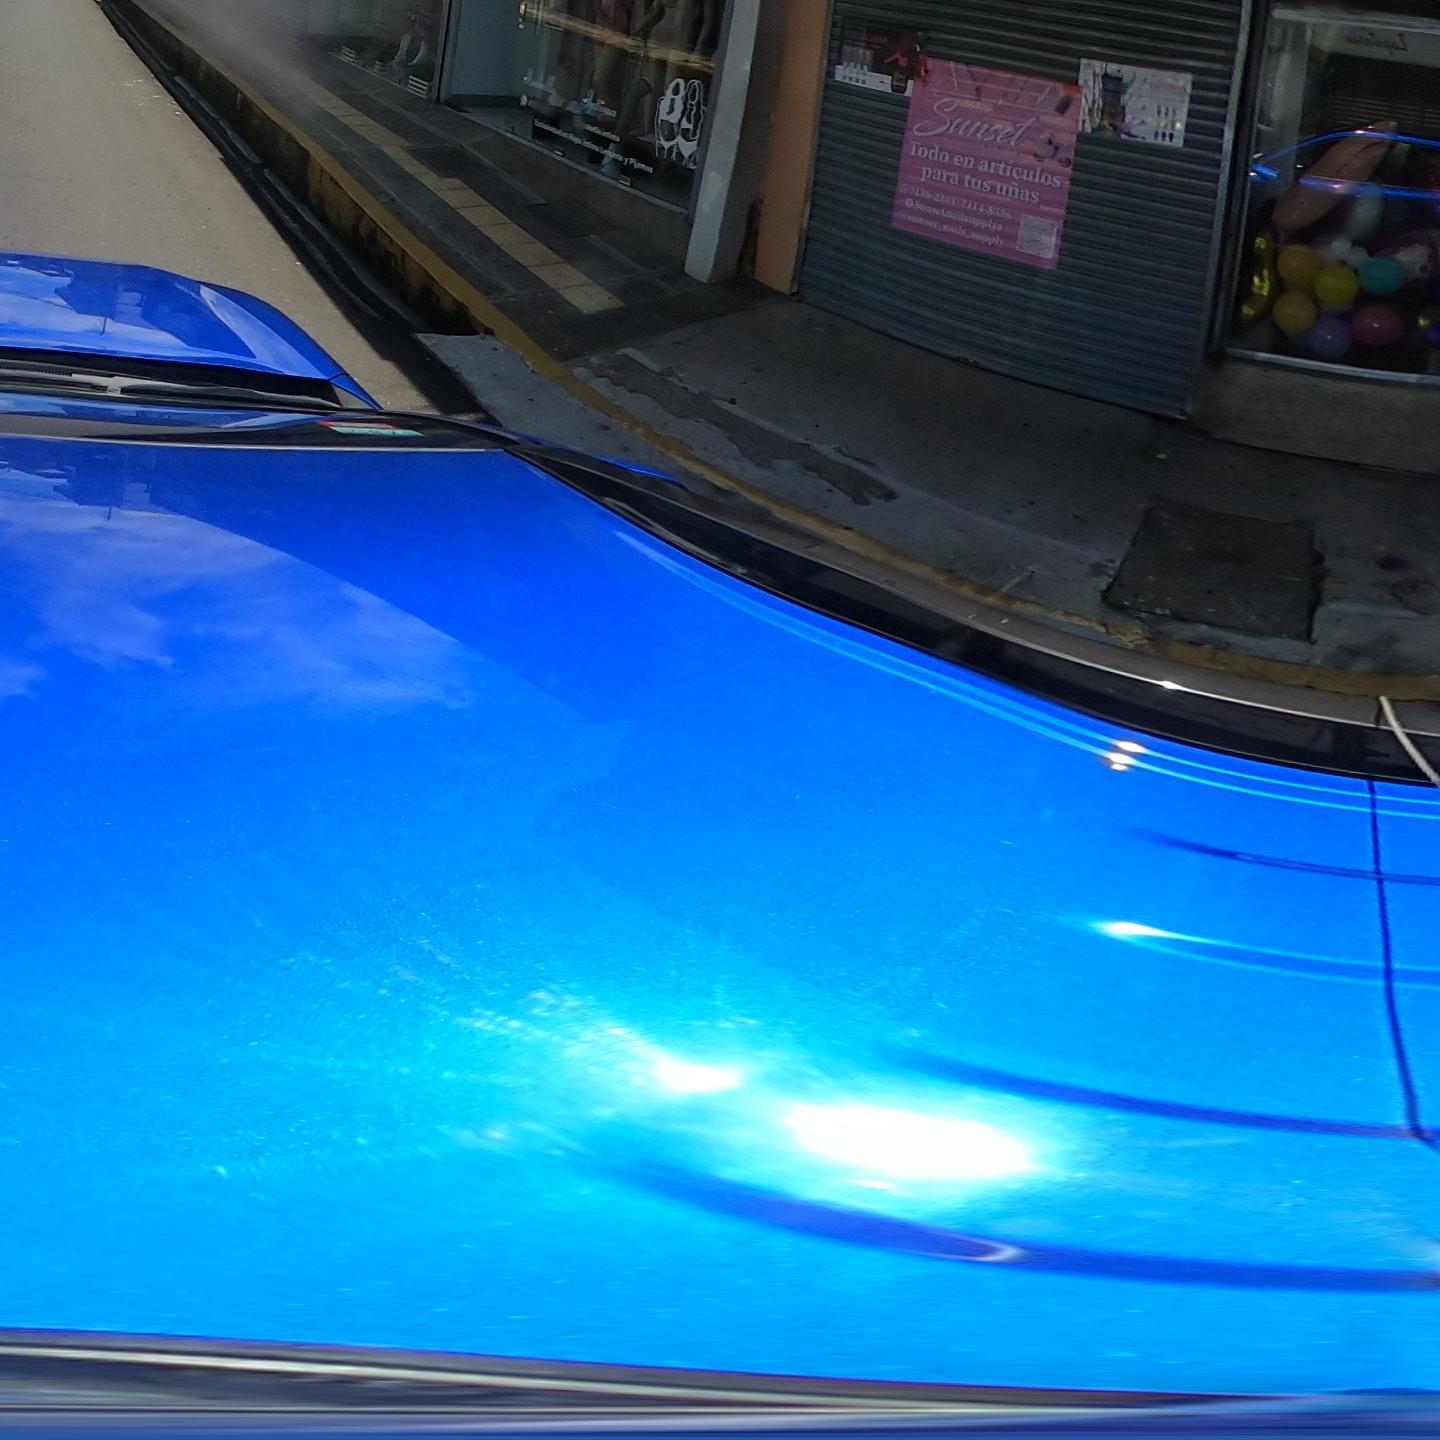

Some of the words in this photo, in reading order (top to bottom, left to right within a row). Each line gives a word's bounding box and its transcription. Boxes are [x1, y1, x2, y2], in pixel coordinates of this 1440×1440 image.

[912, 96, 1040, 146] Sunset
[910, 141, 950, 163] Todo
[953, 153, 975, 169] en
[919, 166, 960, 185] para
[964, 174, 992, 192] tus
[995, 181, 1040, 203] uñas
